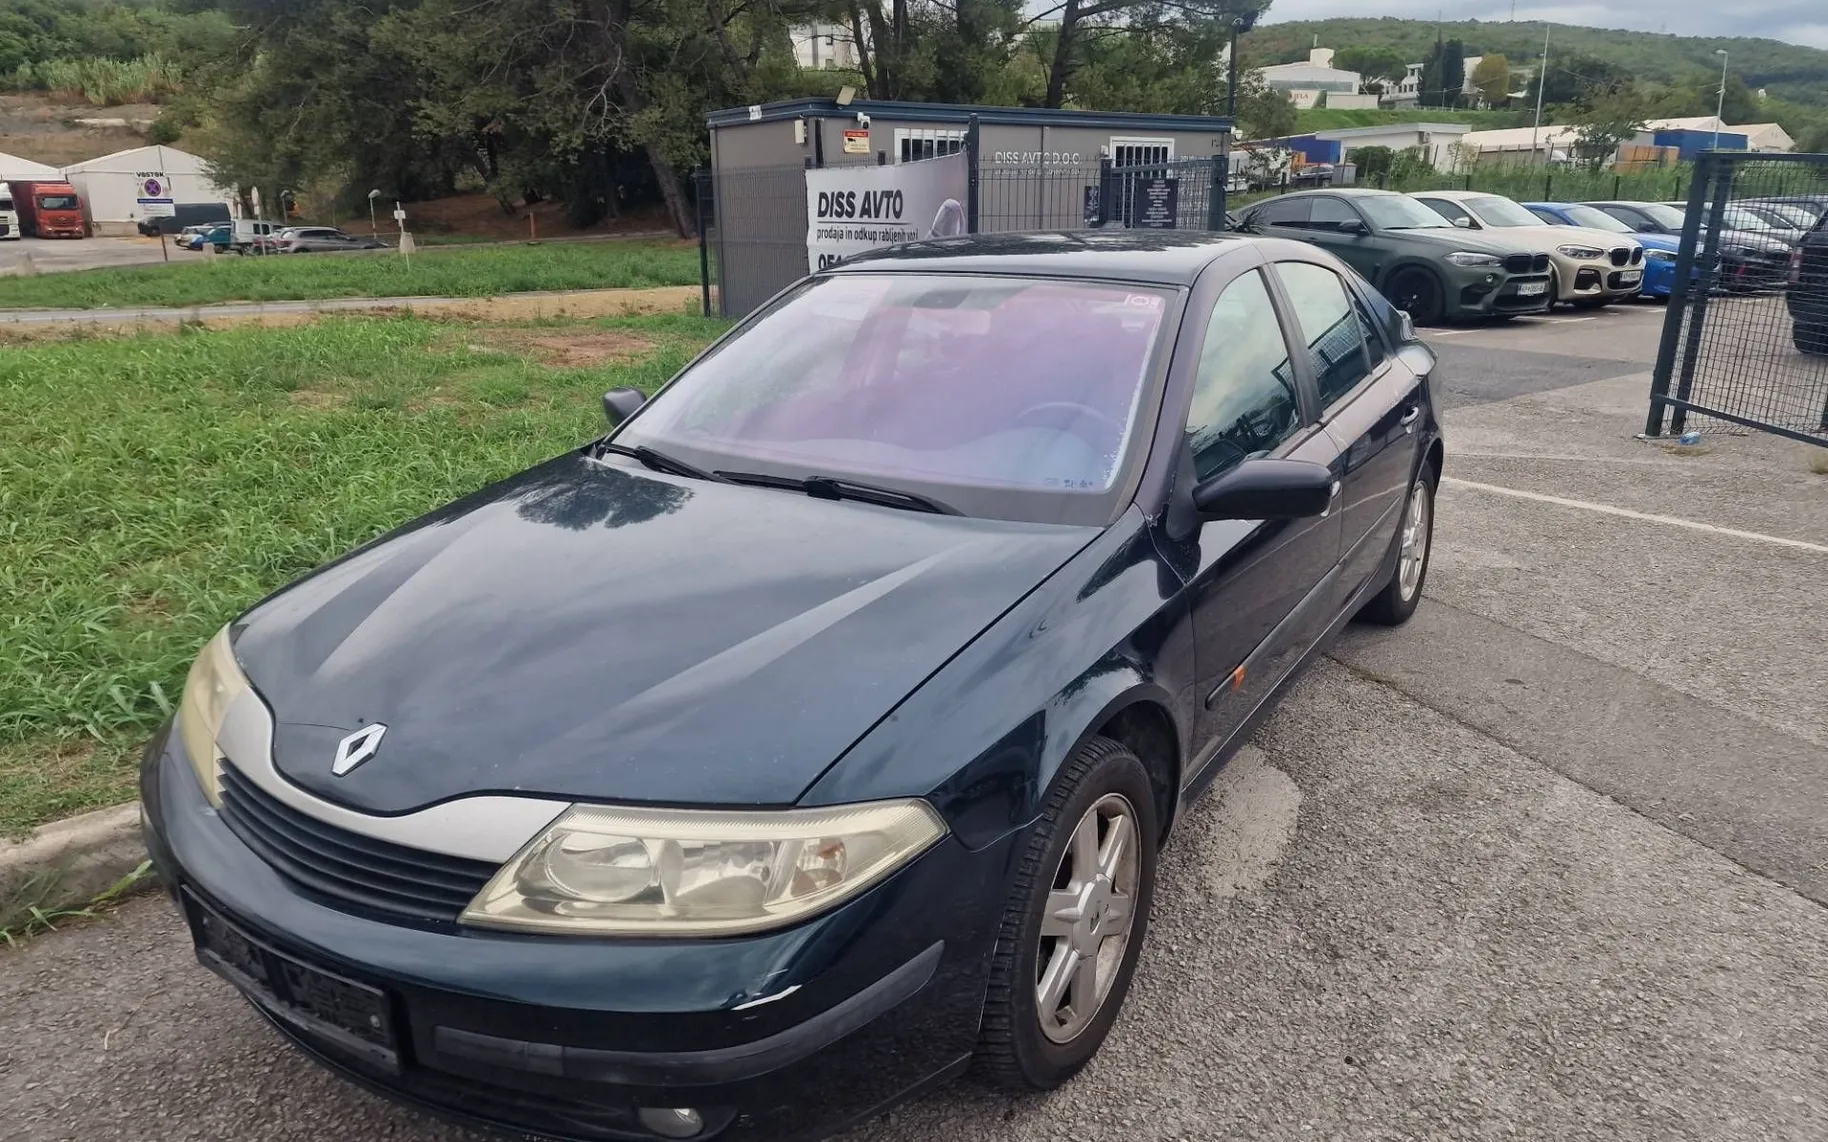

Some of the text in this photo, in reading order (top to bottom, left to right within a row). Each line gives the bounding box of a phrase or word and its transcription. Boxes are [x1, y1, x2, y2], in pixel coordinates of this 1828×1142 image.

[995, 151, 1019, 164] DISS
[817, 189, 904, 219] DISS AVTO
[816, 227, 844, 242] prodaja
[845, 226, 853, 240] in
[854, 226, 878, 245] odkup
[879, 228, 906, 244] rabljenih
